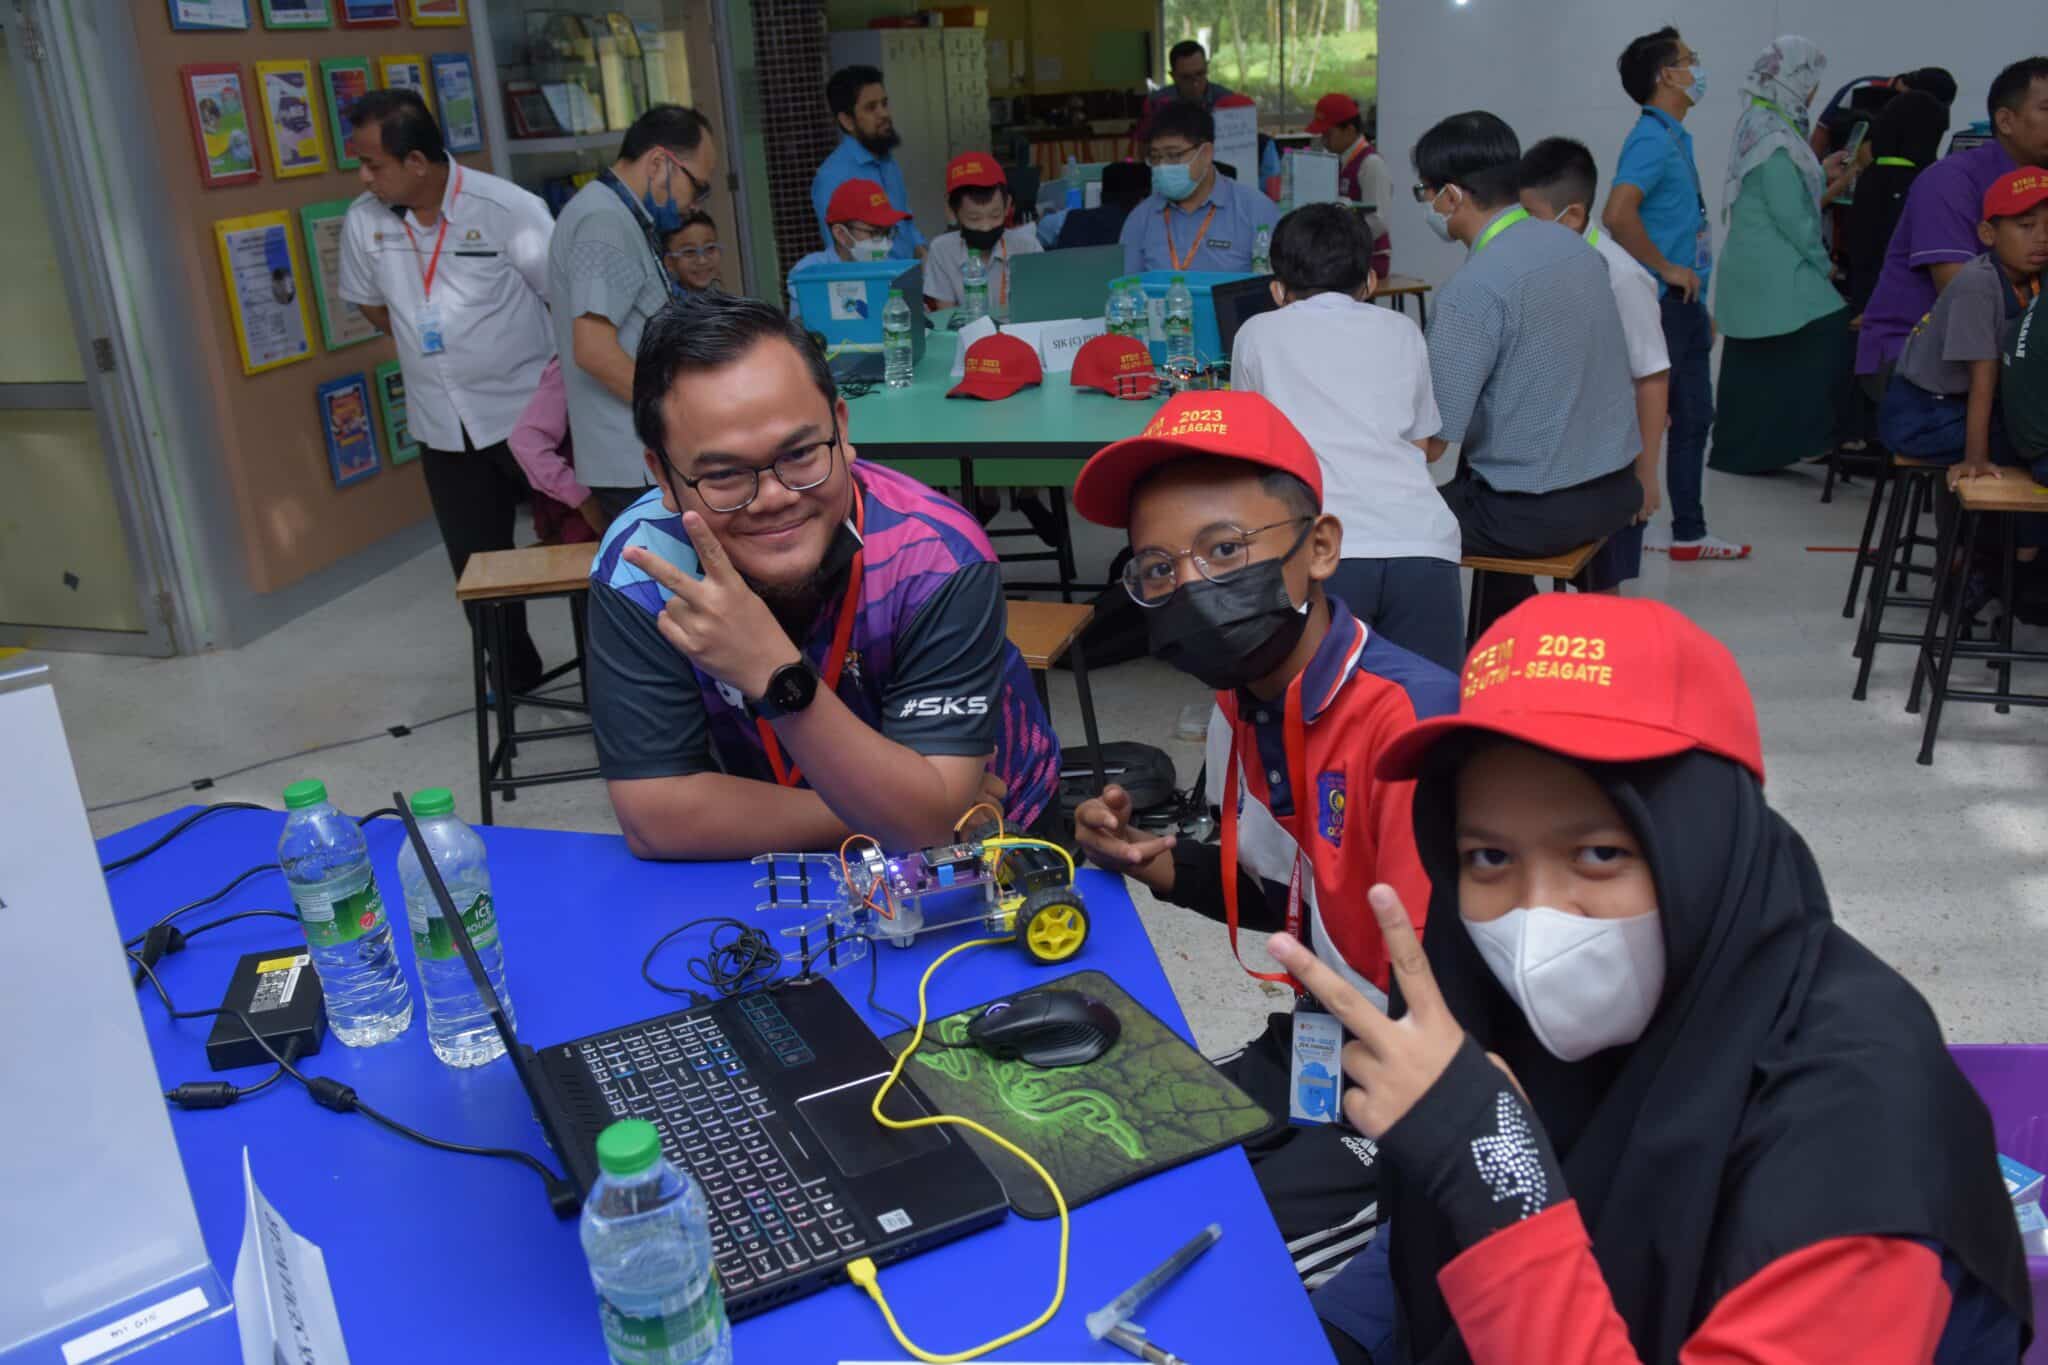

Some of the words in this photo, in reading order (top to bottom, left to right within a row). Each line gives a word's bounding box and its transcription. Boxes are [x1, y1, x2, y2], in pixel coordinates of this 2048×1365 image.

[1178, 409, 1223, 424] 2023
[1170, 423, 1229, 436] SEAGATE
[1537, 634, 1606, 660] 2023
[1524, 661, 1613, 687] SEAGATE
[899, 695, 988, 719] #SKS
[1340, 1135, 1374, 1168] adidas
